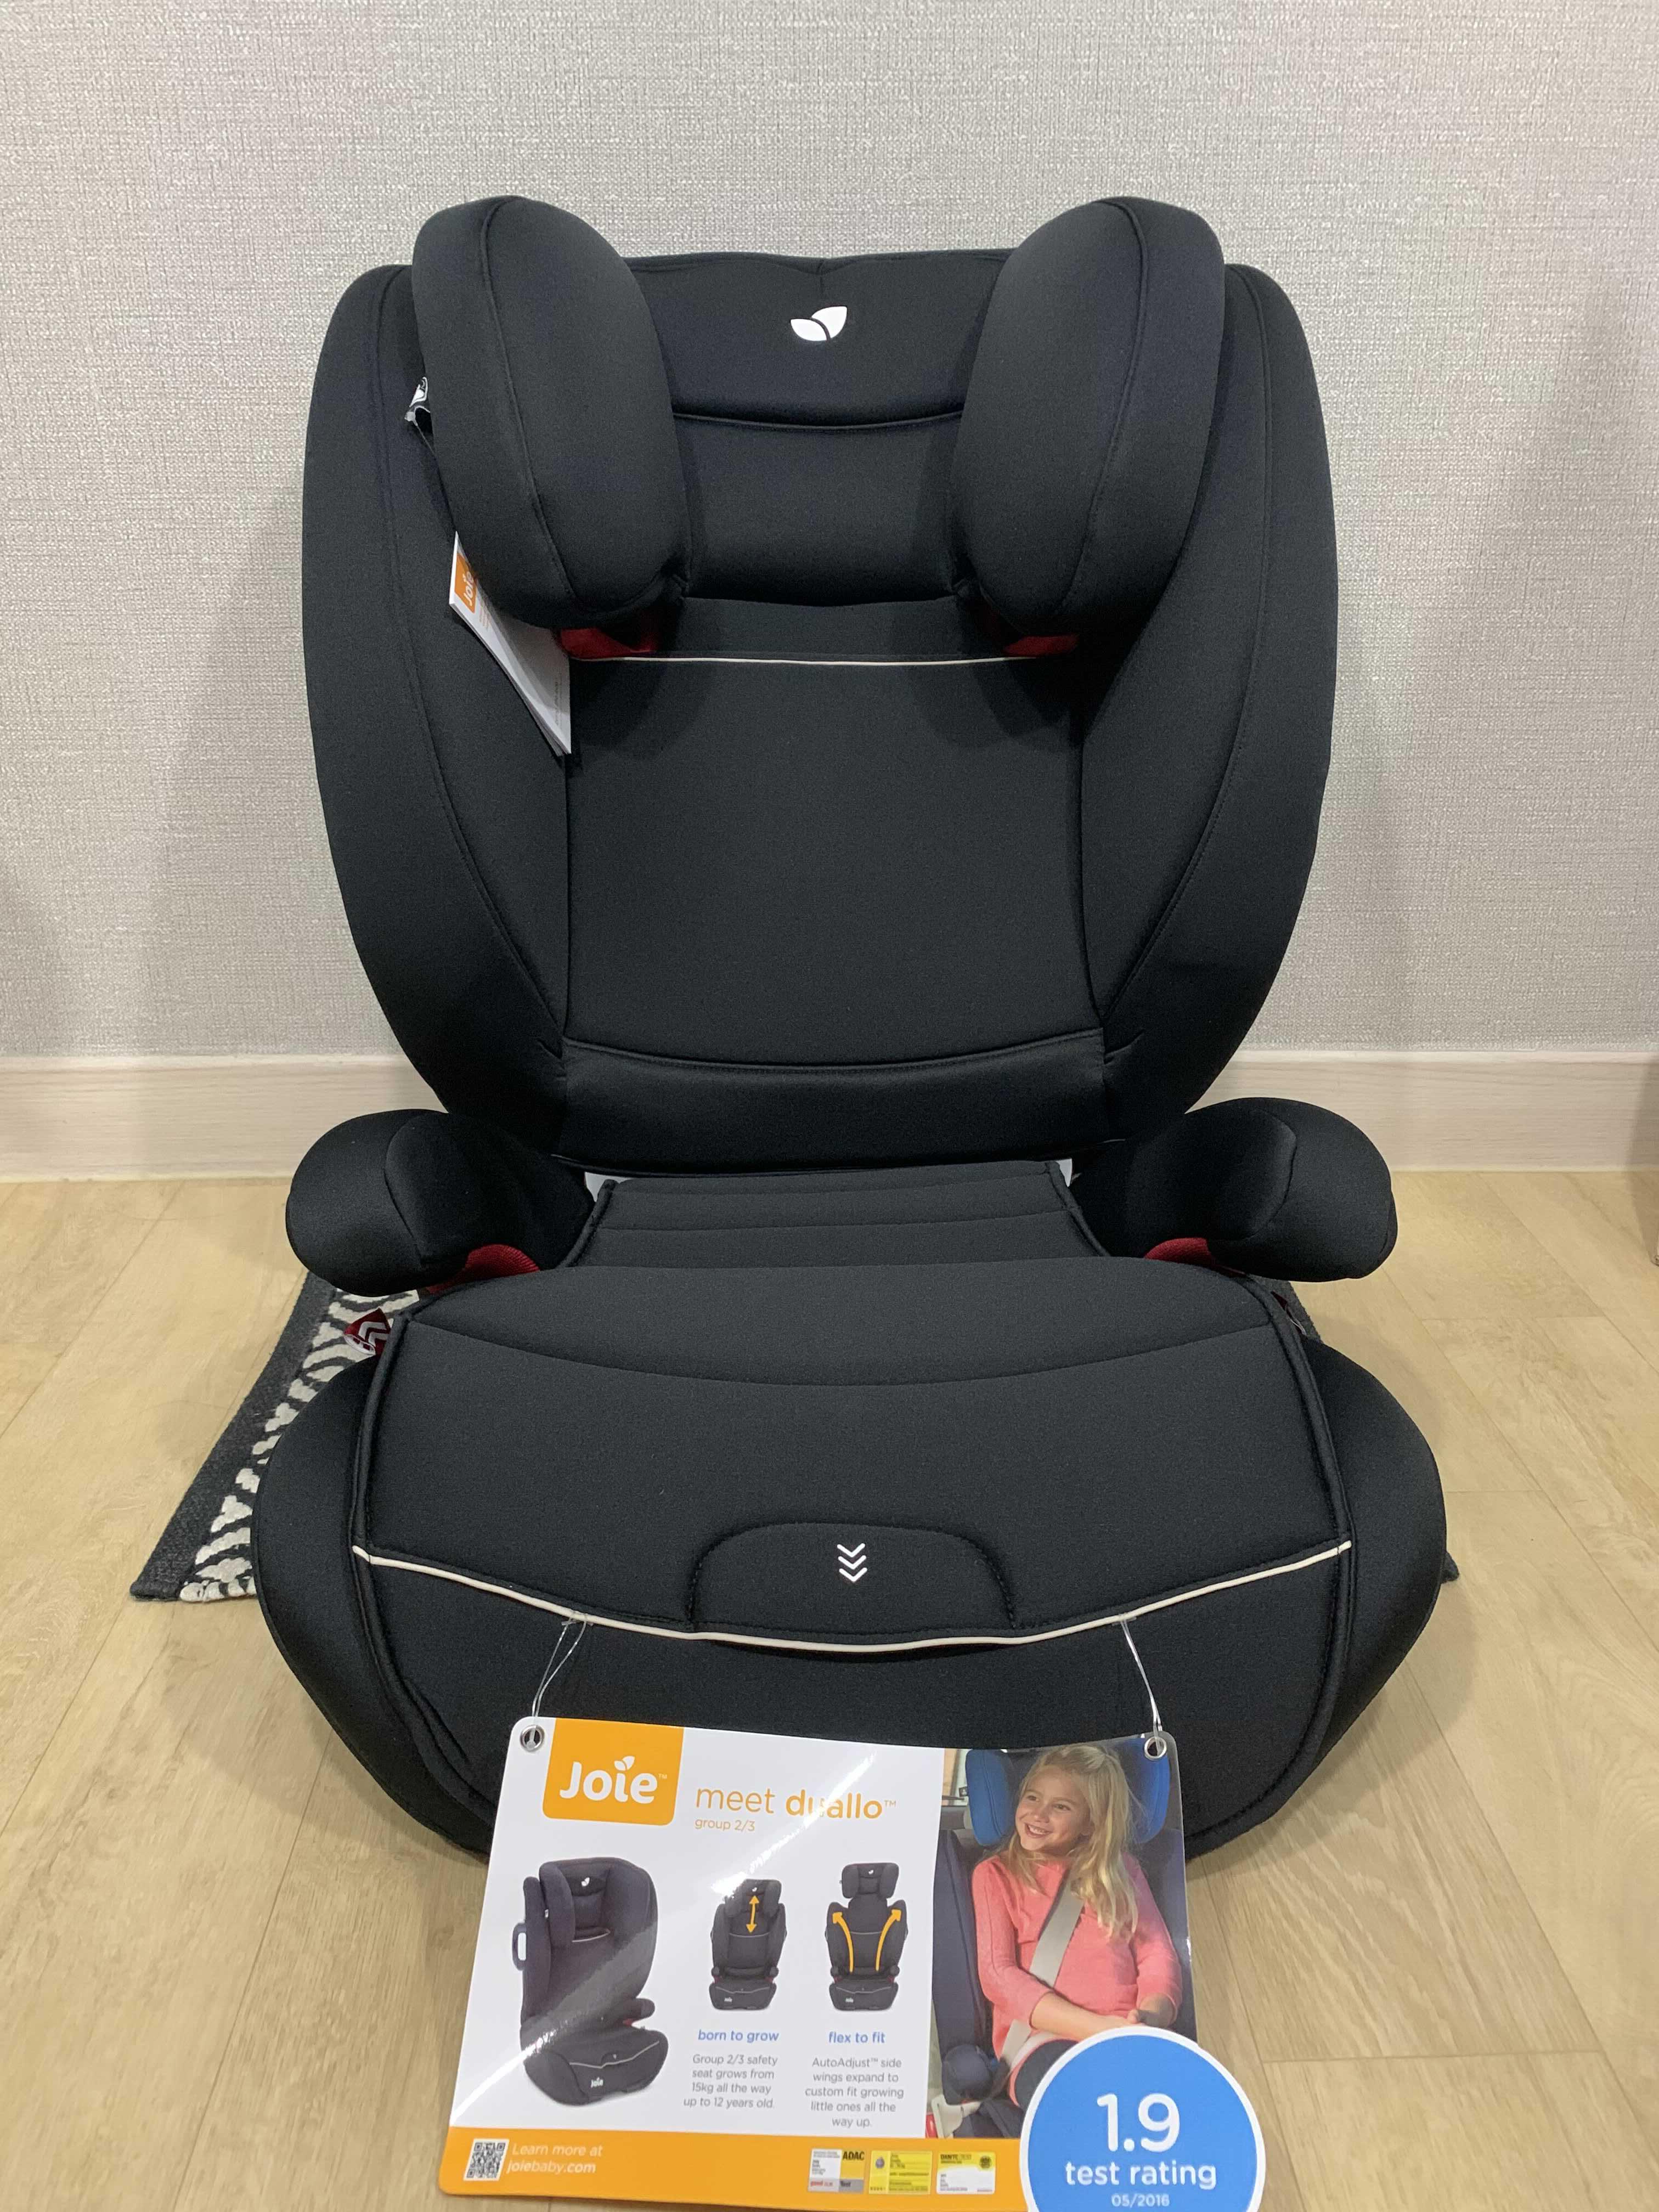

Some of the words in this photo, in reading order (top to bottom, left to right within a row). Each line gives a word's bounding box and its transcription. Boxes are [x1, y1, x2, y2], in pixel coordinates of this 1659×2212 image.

[462, 571, 475, 606] Joie
[696, 1788, 775, 1814] meet
[695, 1819, 731, 1831] group
[735, 1820, 755, 1831] 2/3
[698, 2029, 726, 2040] born
[731, 2030, 743, 2041] to
[747, 2032, 779, 2043] grow
[829, 2032, 851, 2043] flex
[855, 2033, 868, 2043] to
[872, 2032, 885, 2043] fit
[693, 2054, 724, 2065] Group
[727, 2054, 744, 2065] 2/3
[747, 2055, 778, 2066] safety
[881, 2058, 902, 2068] side
[692, 2069, 713, 2078] seat
[716, 2070, 747, 2080] grows
[751, 2069, 774, 2079] from
[813, 2072, 843, 2084] wings
[846, 2073, 884, 2083] expand
[888, 2073, 899, 2082] to
[692, 2082, 713, 2094] 15kg
[716, 2083, 727, 2092] all
[731, 2083, 747, 2093] the
[751, 2085, 771, 2095] way
[805, 2087, 843, 2096] custom
[847, 2086, 857, 2097] fit
[860, 2088, 904, 2099] growing
[684, 2098, 697, 2108] up
[700, 2097, 711, 2107] to
[714, 2097, 724, 2107] 12
[726, 2100, 753, 2109] years
[811, 2102, 833, 2111] little
[836, 2103, 861, 2112] ones
[864, 2102, 876, 2112] all
[879, 2102, 896, 2112] the
[832, 2118, 854, 2128] way
[1097, 2093, 1181, 2153] 1.9
[512, 2143, 549, 2156] Learn
[552, 2145, 585, 2156] more
[589, 2145, 603, 2157] at
[843, 2151, 865, 2160] ADAC
[506, 2160, 596, 2175] joiebaby.com
[1066, 2161, 1120, 2185] test
[1130, 2160, 1217, 2190] rating
